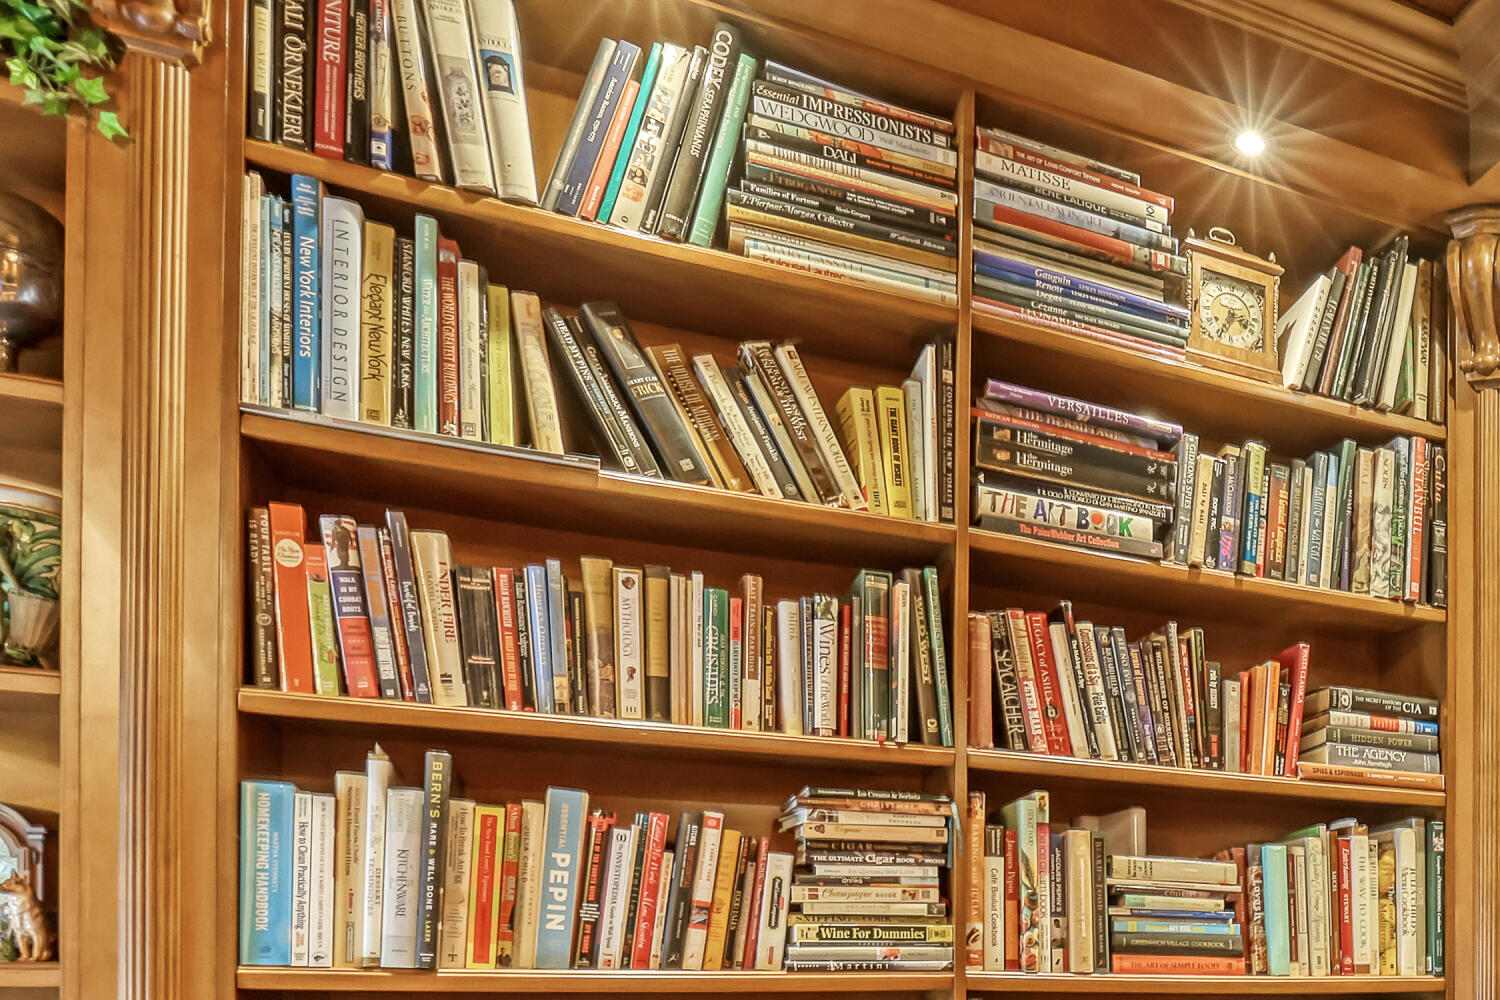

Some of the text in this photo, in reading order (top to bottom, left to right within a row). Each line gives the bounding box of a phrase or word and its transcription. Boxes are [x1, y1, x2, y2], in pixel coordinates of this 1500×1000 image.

[396, 15, 417, 92] BUTTONS
[711, 30, 733, 91] CODEX
[756, 84, 932, 145] Essential IMPRESSIONISTS
[760, 99, 876, 144] WEDGWOOD
[750, 182, 782, 198] Families
[781, 189, 790, 200] of
[789, 191, 820, 207] Fortune
[1000, 159, 1071, 192] MATISSE
[817, 212, 856, 230] Collector
[1063, 193, 1108, 215] LALIQUE
[299, 236, 316, 358] New York Interiors
[1034, 267, 1072, 286] Gauguin
[1034, 279, 1065, 294] Renoir
[331, 219, 350, 402] INTERIOR DESIGN
[401, 240, 414, 358] STANFORD NEW
[363, 273, 388, 382] Elegant New York
[441, 276, 455, 404] THE GREATEST BUILDINGS
[556, 318, 594, 382] READ MY PINS
[662, 348, 681, 364] THE
[597, 370, 641, 450] AMERICAN MANSIONS
[631, 382, 665, 399] FRICK
[946, 387, 954, 429] COVERING
[1047, 395, 1130, 425] VERSAILLES
[747, 405, 780, 463] Benjamin Franklin
[946, 431, 954, 448] THE
[1016, 430, 1074, 456] Hermitage
[946, 451, 954, 467] NEW
[1016, 451, 1073, 477] Hermitage
[1434, 454, 1446, 504] Cuba
[983, 490, 1028, 519] THE
[1033, 499, 1073, 527] ART
[1076, 507, 1134, 538] BOOK
[1184, 484, 1194, 510] SPIES
[1412, 461, 1426, 537] ISTANBUL
[260, 513, 271, 541] YOUR
[1019, 522, 1120, 550] The Art Collection
[1219, 534, 1234, 559] 1776
[438, 561, 457, 644] UNDER FIRE
[620, 597, 633, 658] MYTHOLOGY
[819, 620, 835, 675] Wines
[1078, 628, 1096, 663] Confessions
[705, 625, 720, 706] CRUSADES
[1031, 616, 1054, 705] LEGACY of ASHES
[1117, 637, 1132, 687] SEE NO EVIL
[995, 649, 1026, 735] SPYCATCHER
[1022, 680, 1043, 736] PETER MAAS
[1090, 691, 1106, 706] Pete
[1402, 701, 1422, 715] CIA
[1335, 745, 1407, 763] THE AGENCY
[1351, 733, 1413, 748] HIDDEN POWER
[425, 760, 444, 911] BERN'S RARE WELL DONE
[255, 792, 271, 931] HOMEKEEPING HANDBOOK
[294, 821, 309, 930] How Clean Practically Anything
[610, 851, 623, 905] INVESTOPEDIA
[865, 853, 895, 865] Cigar
[1341, 847, 1350, 890] Entertaining
[544, 851, 572, 931] PEPIN
[821, 887, 872, 900] Champagne
[841, 877, 863, 885] drinks
[971, 887, 980, 916] JULIA
[1252, 880, 1264, 921] Lavash
[820, 927, 925, 940] Wine For Dummies
[990, 913, 999, 947] Cookbook
[1359, 920, 1367, 948] COOK
